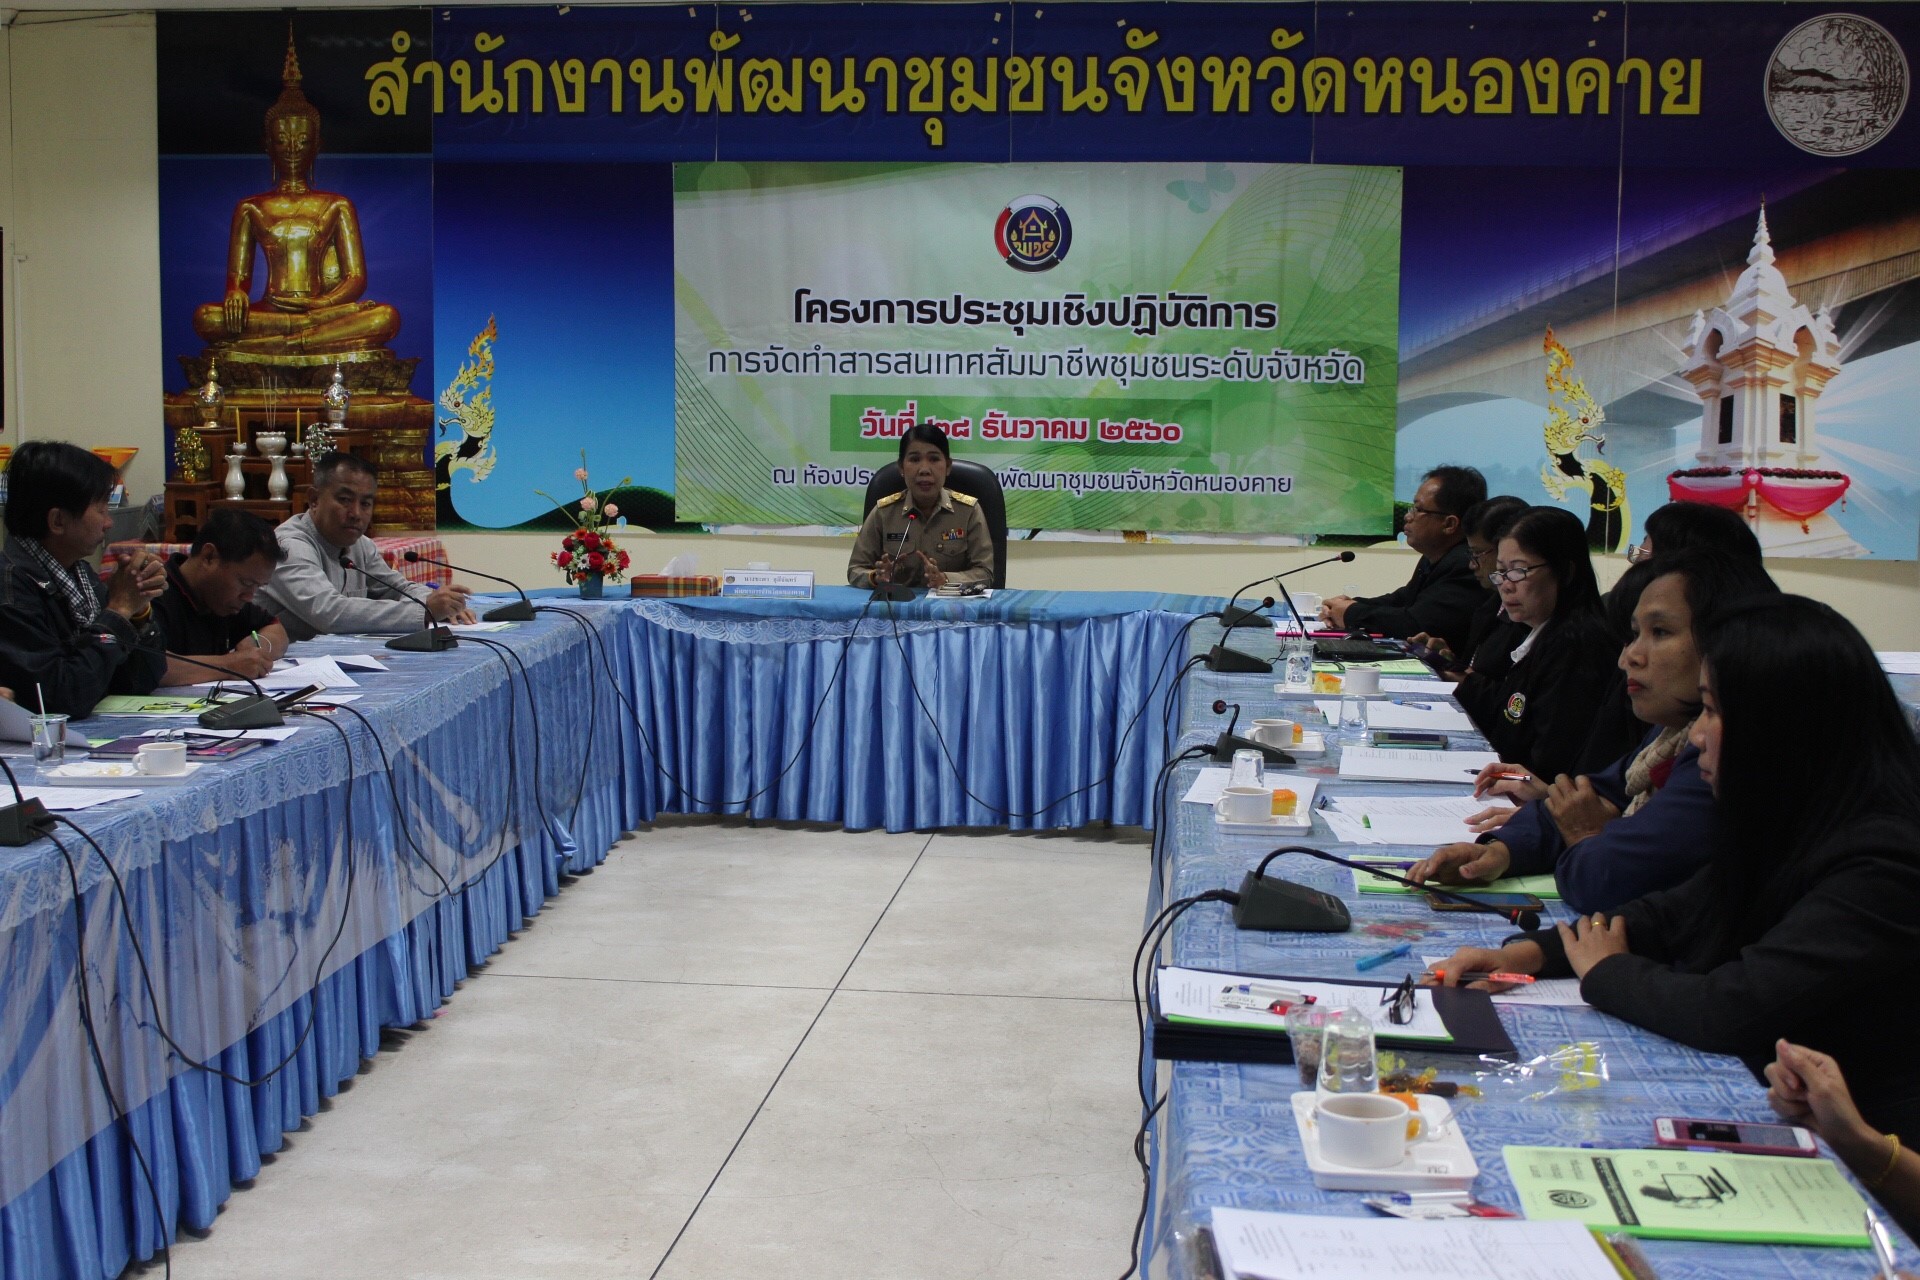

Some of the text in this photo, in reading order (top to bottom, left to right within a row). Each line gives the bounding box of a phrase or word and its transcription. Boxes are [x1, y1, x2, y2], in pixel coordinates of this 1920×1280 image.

[364, 28, 1703, 146] สำนักงานพัฒนาชุมชนจังหวัดหนองคาย
[794, 288, 1277, 336] โครงการประชุมเชิงปฏิบัติการ
[708, 344, 1362, 386] การจัดทำสารสนเทศสัมมาชีพชุมชนระดับจังหวัด
[861, 402, 915, 437] วันที่
[982, 411, 1087, 440] ธันวาคม
[1100, 420, 1181, 441] ๒๕๖๐
[773, 467, 796, 485] ณ
[997, 467, 1292, 495] พัฒนาชุมชนจังหวัดหนองคาย
